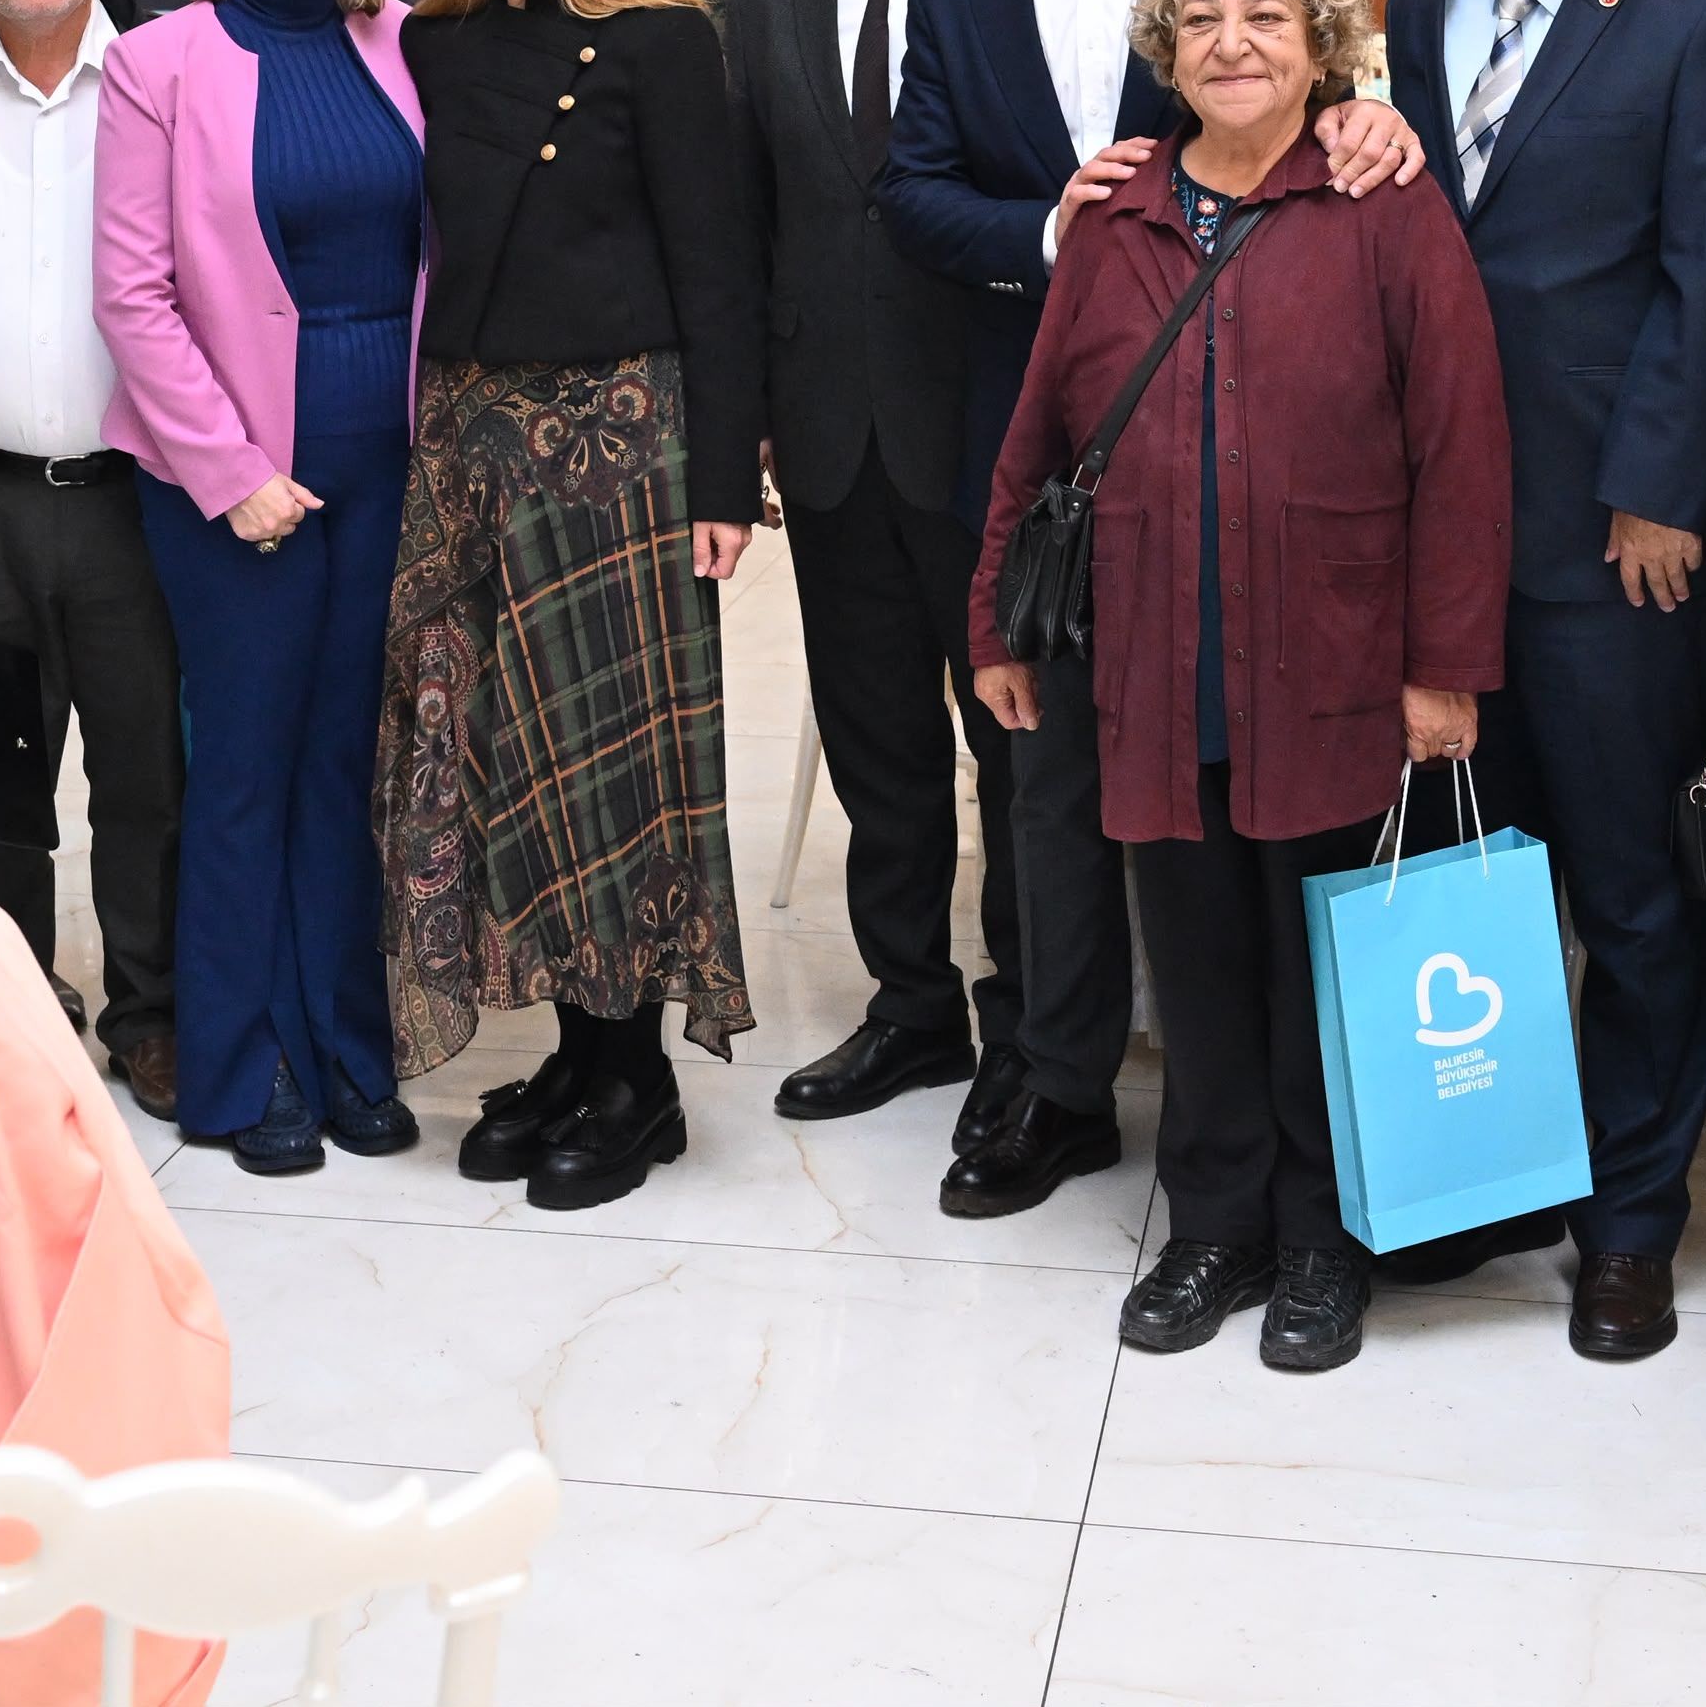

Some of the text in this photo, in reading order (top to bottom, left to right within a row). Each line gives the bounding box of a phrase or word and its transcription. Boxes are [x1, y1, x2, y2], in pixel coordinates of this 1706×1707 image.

[1435, 1048, 1484, 1071] BALIKESİR
[1436, 1060, 1497, 1085] BÜYÜKŞEHİR
[1438, 1074, 1492, 1100] BELEDİYESİ
